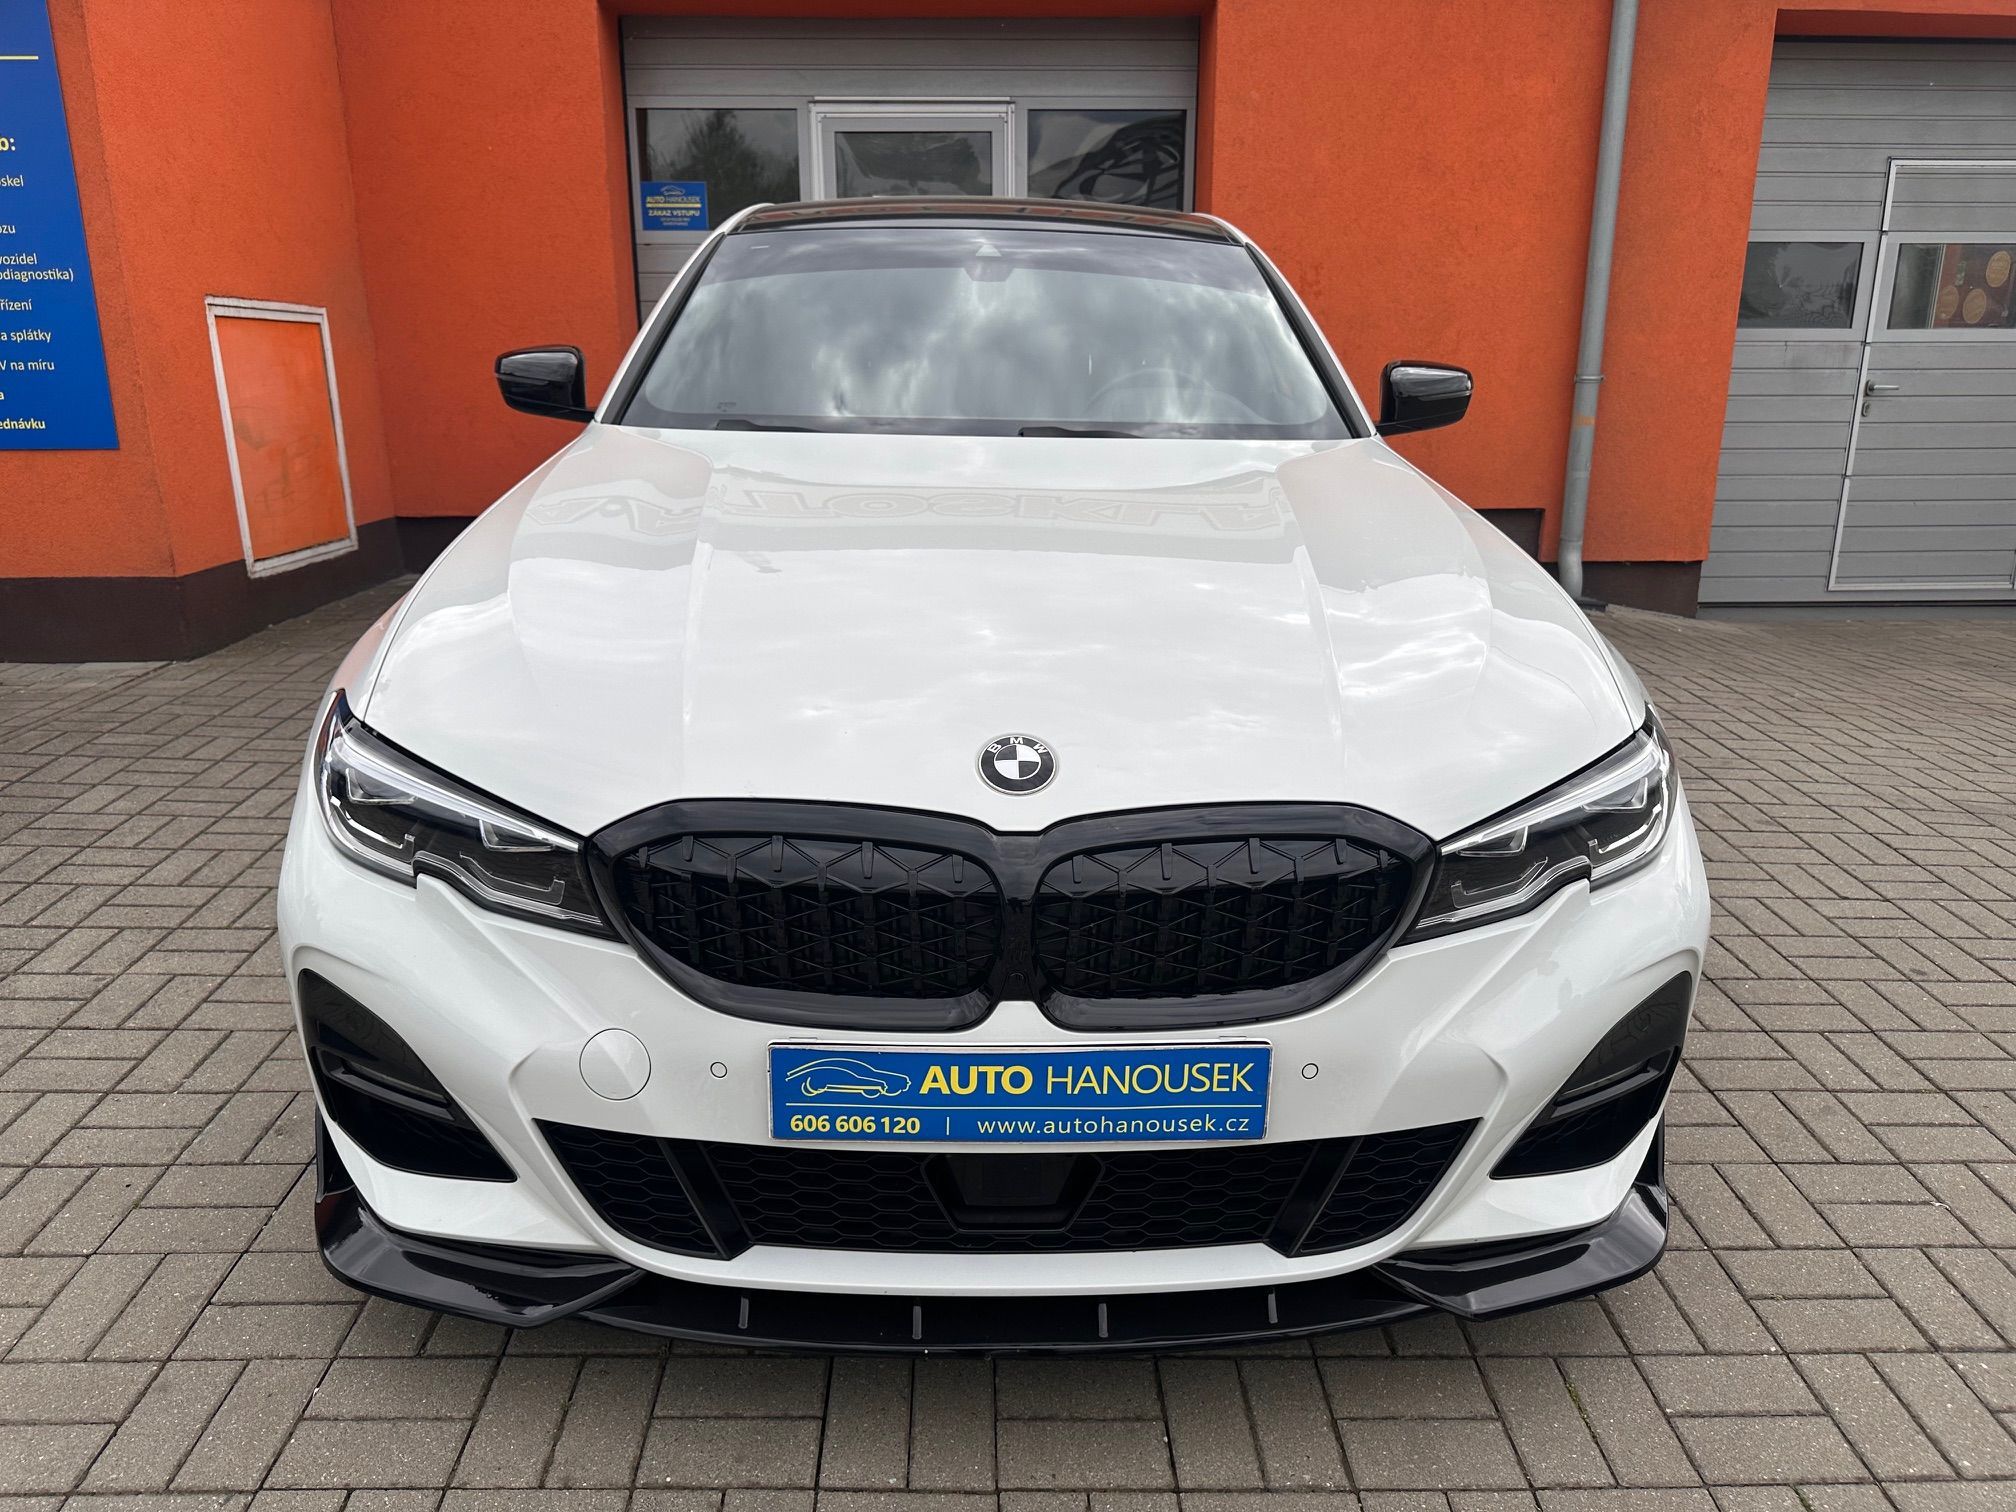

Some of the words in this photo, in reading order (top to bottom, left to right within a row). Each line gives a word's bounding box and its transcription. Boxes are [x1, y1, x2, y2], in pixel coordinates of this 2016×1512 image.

[0, 174, 24, 187] skel
[10, 329, 51, 343] splátky
[10, 361, 25, 371] na
[27, 358, 55, 371] míru
[986, 736, 1049, 754] BMW
[919, 1065, 1034, 1095] AUTO
[1046, 1062, 1255, 1095] HANOUSEK
[790, 1114, 831, 1133] 606
[835, 1115, 877, 1134] 606
[880, 1116, 921, 1135] 120
[977, 1113, 1250, 1135] www.autohanousek.cz
